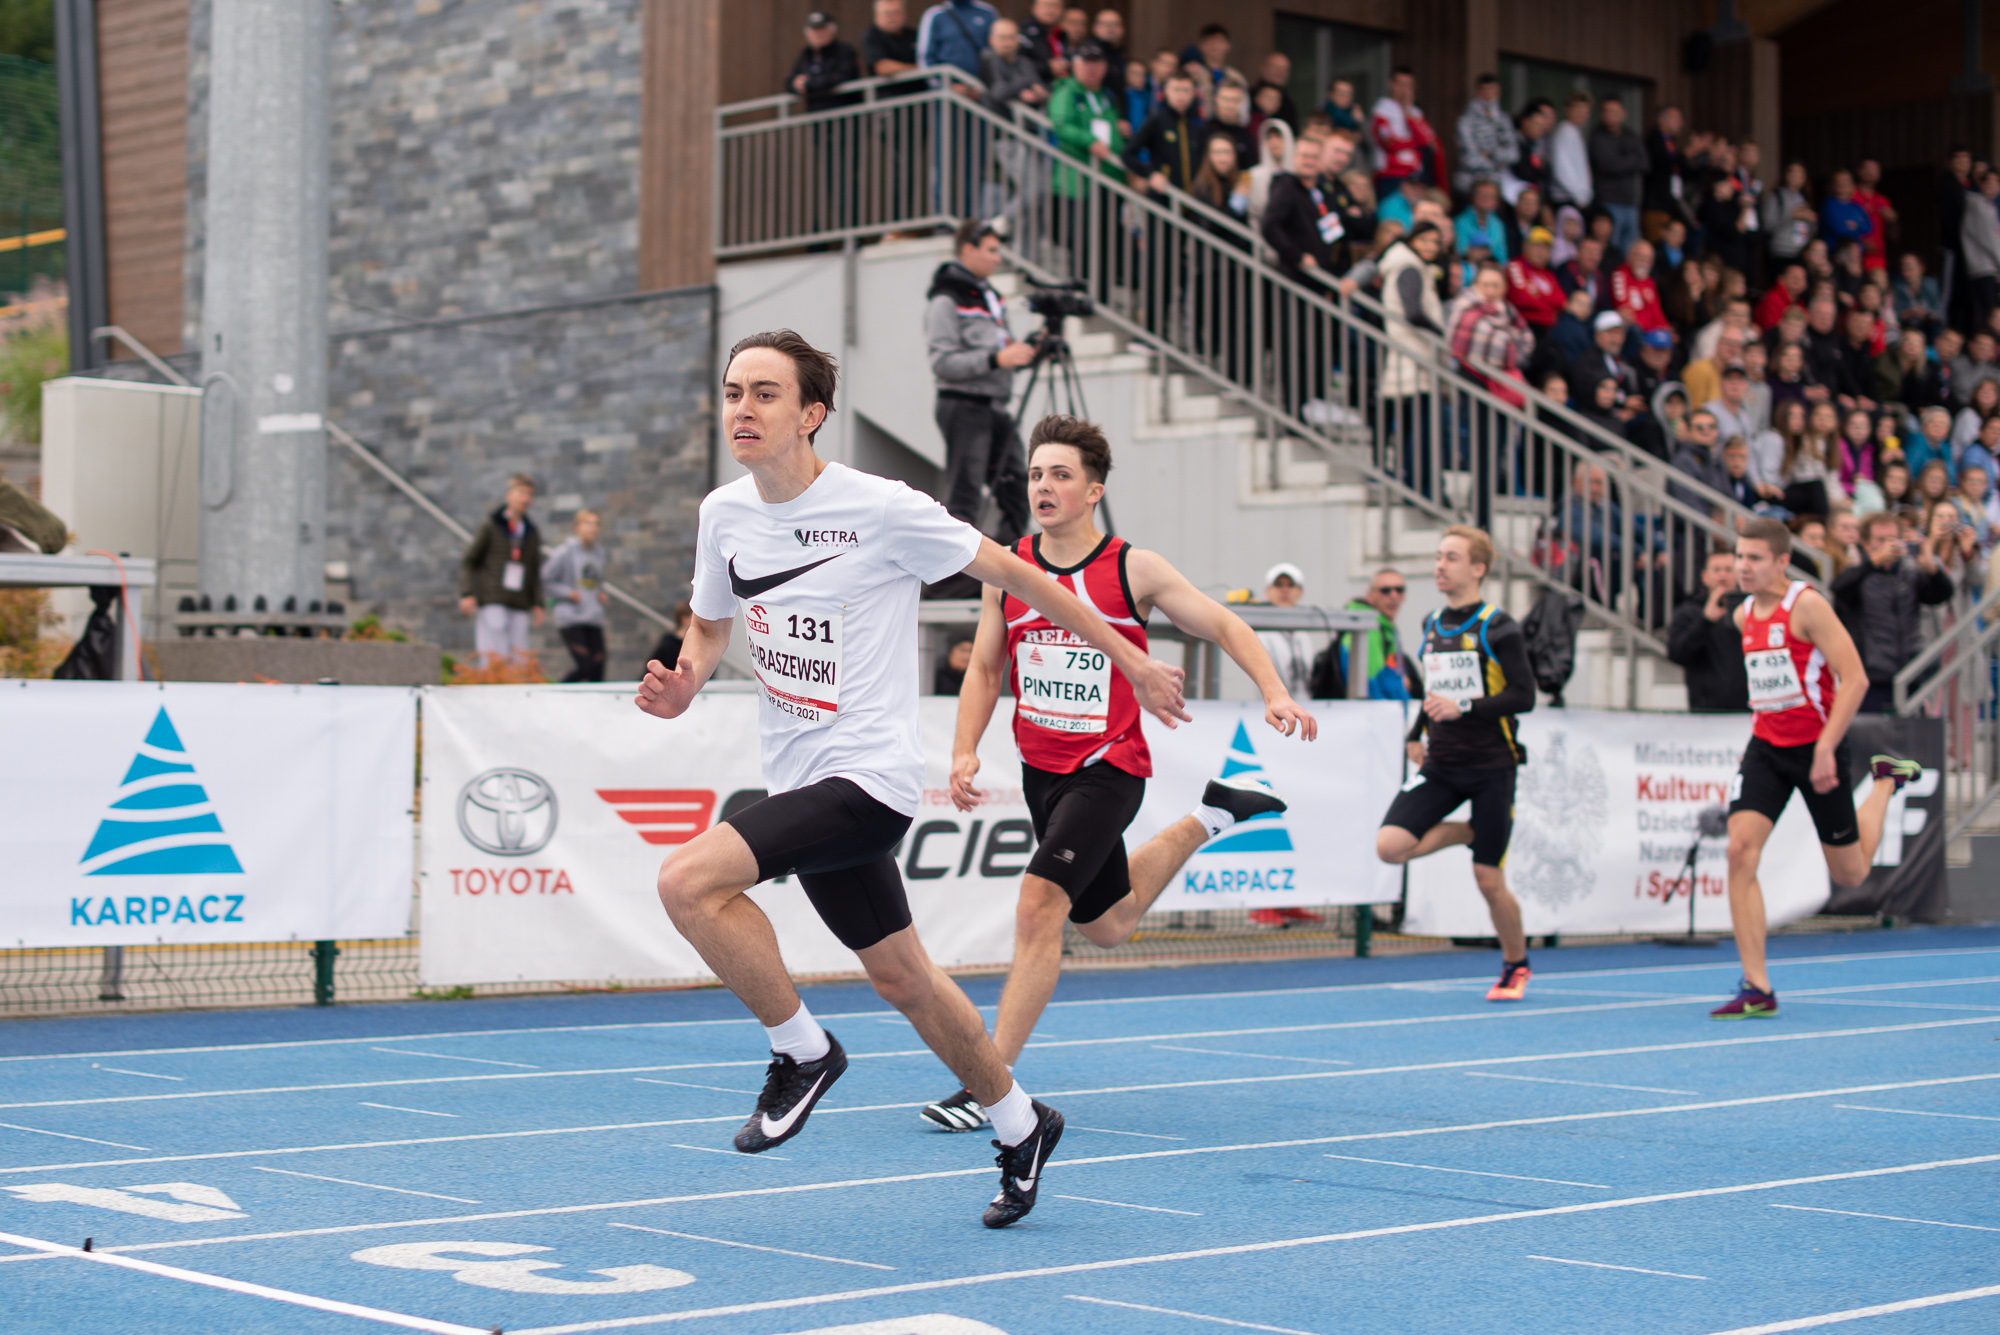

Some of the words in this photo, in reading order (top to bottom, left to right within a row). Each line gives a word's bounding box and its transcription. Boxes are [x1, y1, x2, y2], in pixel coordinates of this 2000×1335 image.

[794, 528, 858, 546] VECTRA
[787, 614, 834, 644] 131
[1023, 629, 1093, 646] RELA
[1066, 651, 1104, 671] 750
[1450, 656, 1474, 669] 105
[1023, 676, 1102, 702] PINTERA
[796, 707, 820, 722] 2021
[1028, 714, 1067, 729] KARPACZ
[1069, 721, 1091, 730] 2021
[1637, 774, 1727, 804] Kultury
[449, 868, 574, 895] TOYOTA
[1184, 868, 1296, 894] KARPACZ
[71, 895, 245, 926] KARPACZ
